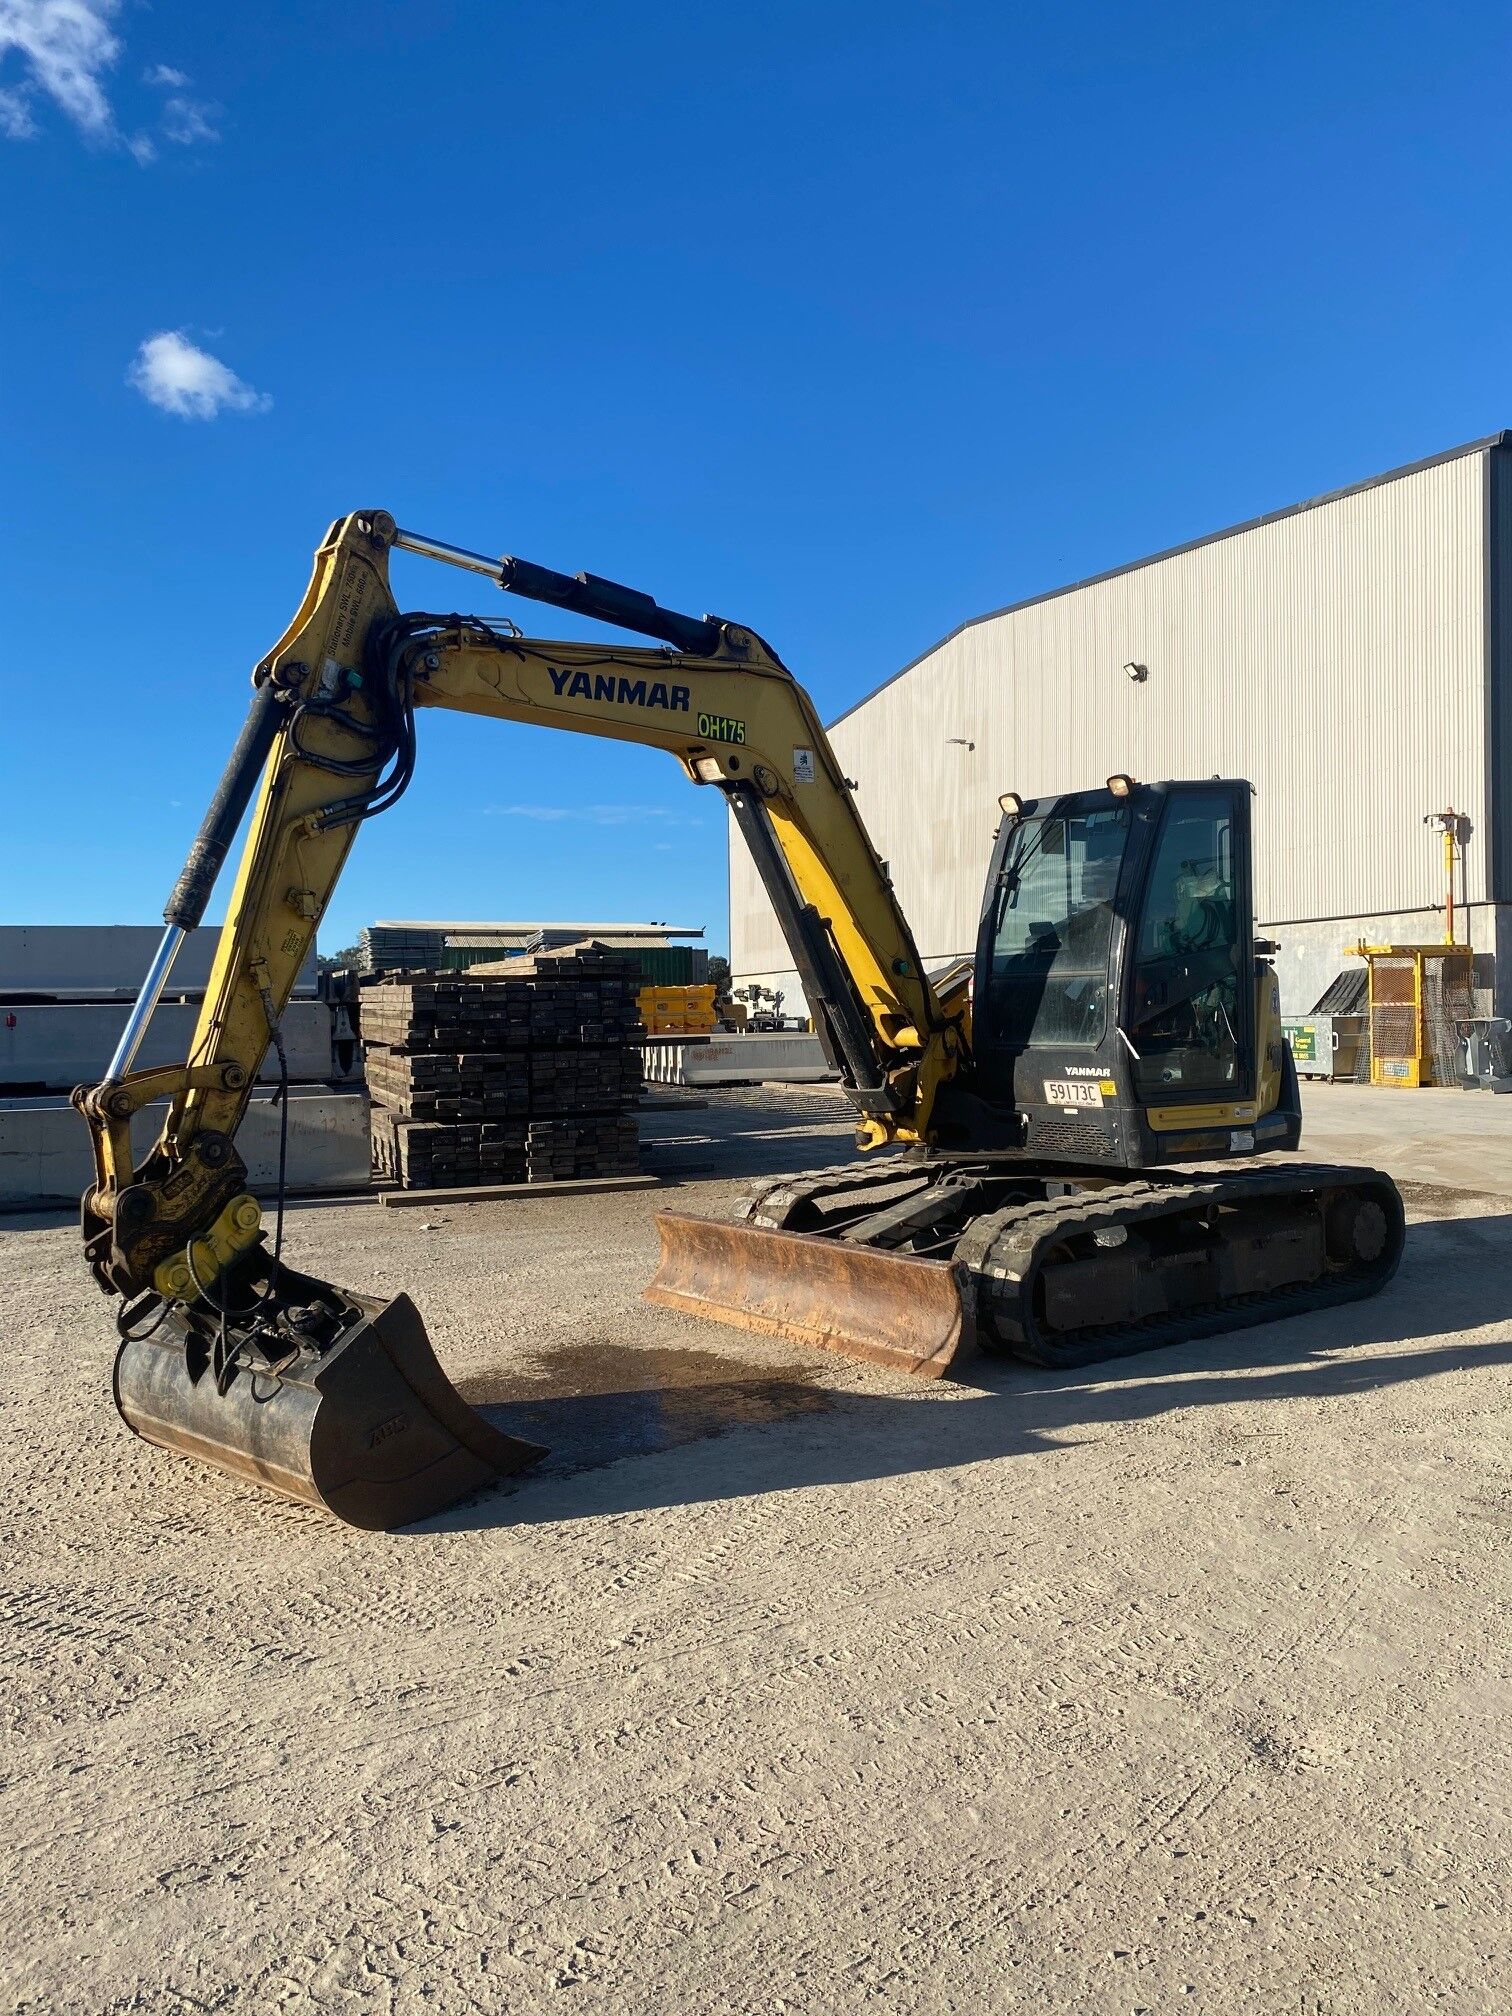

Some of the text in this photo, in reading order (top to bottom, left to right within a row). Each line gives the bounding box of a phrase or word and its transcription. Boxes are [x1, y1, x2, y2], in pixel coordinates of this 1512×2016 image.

[546, 666, 691, 712] YANMAR
[698, 713, 745, 744] OH175
[1064, 1066, 1111, 1077] YANMAR
[1049, 1083, 1097, 1101] 59173C
